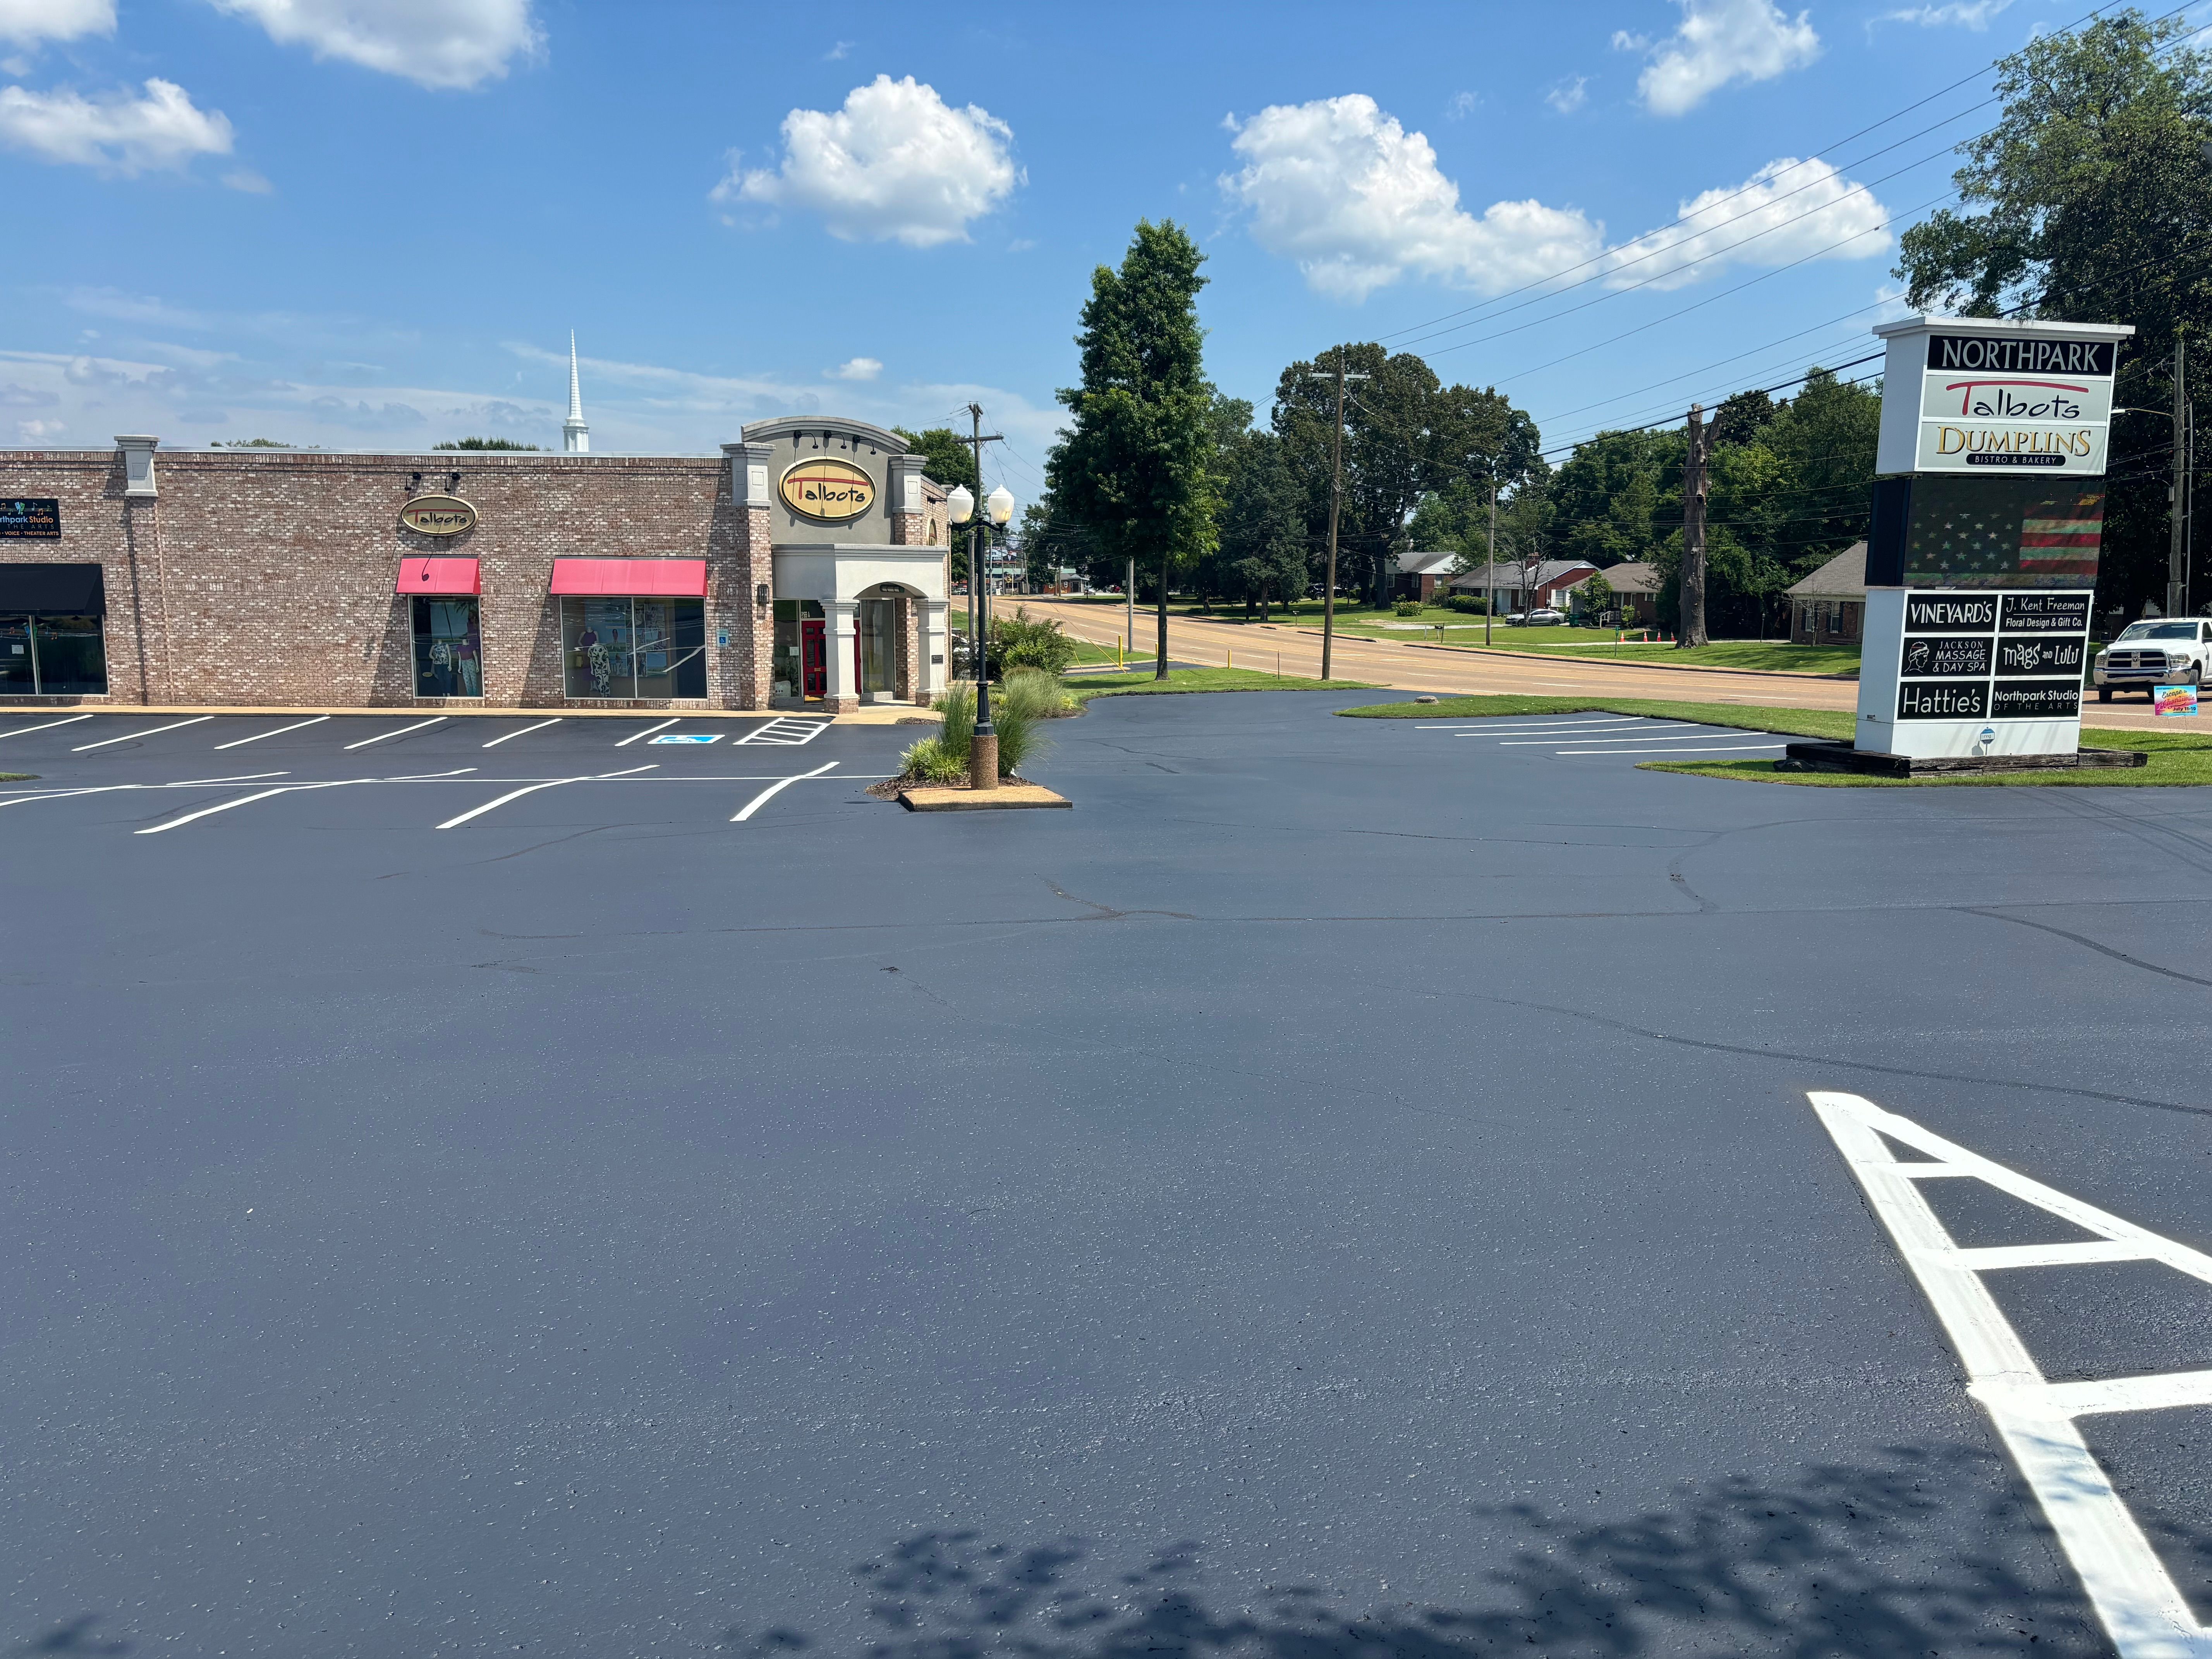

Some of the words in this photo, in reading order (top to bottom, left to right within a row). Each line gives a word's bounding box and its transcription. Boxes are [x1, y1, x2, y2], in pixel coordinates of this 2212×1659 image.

[1942, 339, 2100, 371] NORTHPARK
[1946, 381, 2089, 419] Talbots
[1936, 426, 2091, 457] DUMPLINS
[787, 477, 869, 503] Talbots
[407, 508, 470, 523] Talbots
[1911, 601, 1992, 623] VINEYARD'S
[2006, 597, 2016, 613] J.
[2021, 597, 2043, 612] Kent
[2047, 597, 2085, 610] Freeman
[2006, 618, 2025, 627] Floral
[2027, 618, 2050, 629] Design
[2051, 618, 2056, 627] &
[2057, 617, 2070, 627] Gift
[2072, 617, 2082, 627] Co.
[1939, 641, 1984, 649] JACKSON
[1936, 649, 1986, 660] MASSAGE
[1932, 662, 1939, 672] &
[1943, 662, 1964, 672] DAY
[1966, 662, 1985, 672] SPA
[1903, 687, 1980, 713] Hattie's
[1994, 690, 2046, 703] Northpark
[2047, 690, 2078, 700] Studio
[2162, 690, 2183, 699] Escape
